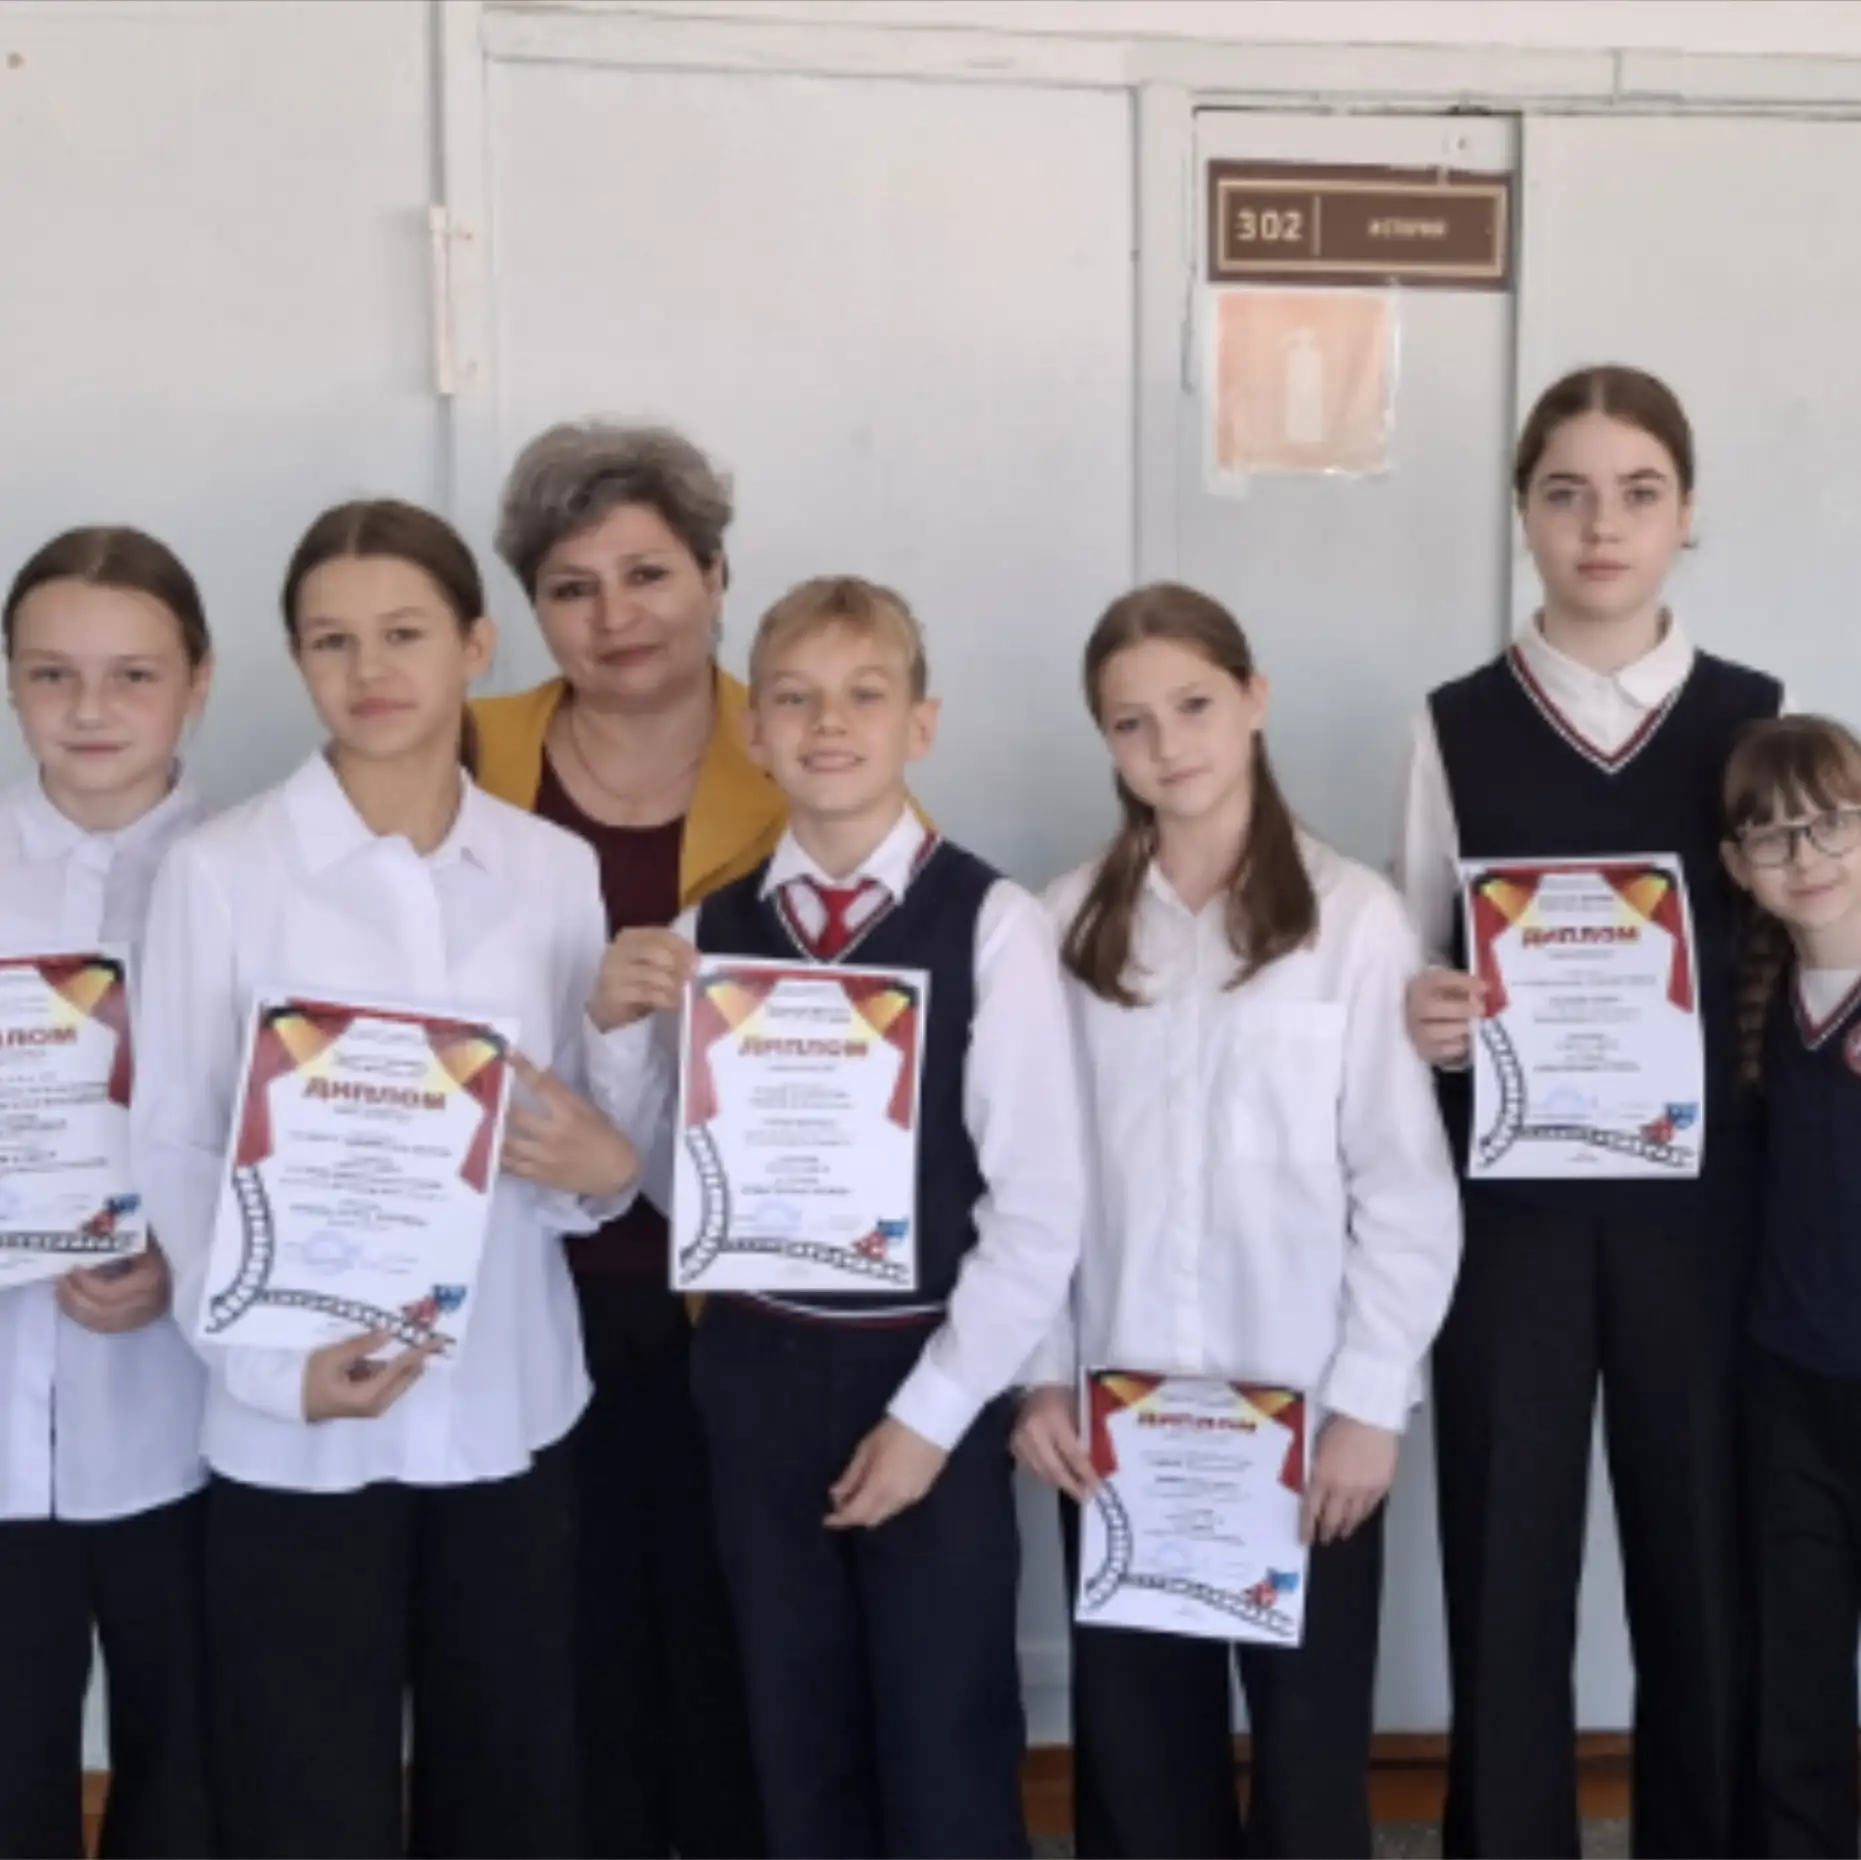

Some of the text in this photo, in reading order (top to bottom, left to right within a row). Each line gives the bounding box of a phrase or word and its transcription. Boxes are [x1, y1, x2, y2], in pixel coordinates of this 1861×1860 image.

[1235, 206, 1303, 242] 302
[1520, 924, 1640, 947] ДИПЛОМ
[0, 1026, 78, 1048] ЛОМ
[737, 1037, 869, 1058] ДИПЛОМ
[301, 1076, 447, 1111] ДИПЛОМ
